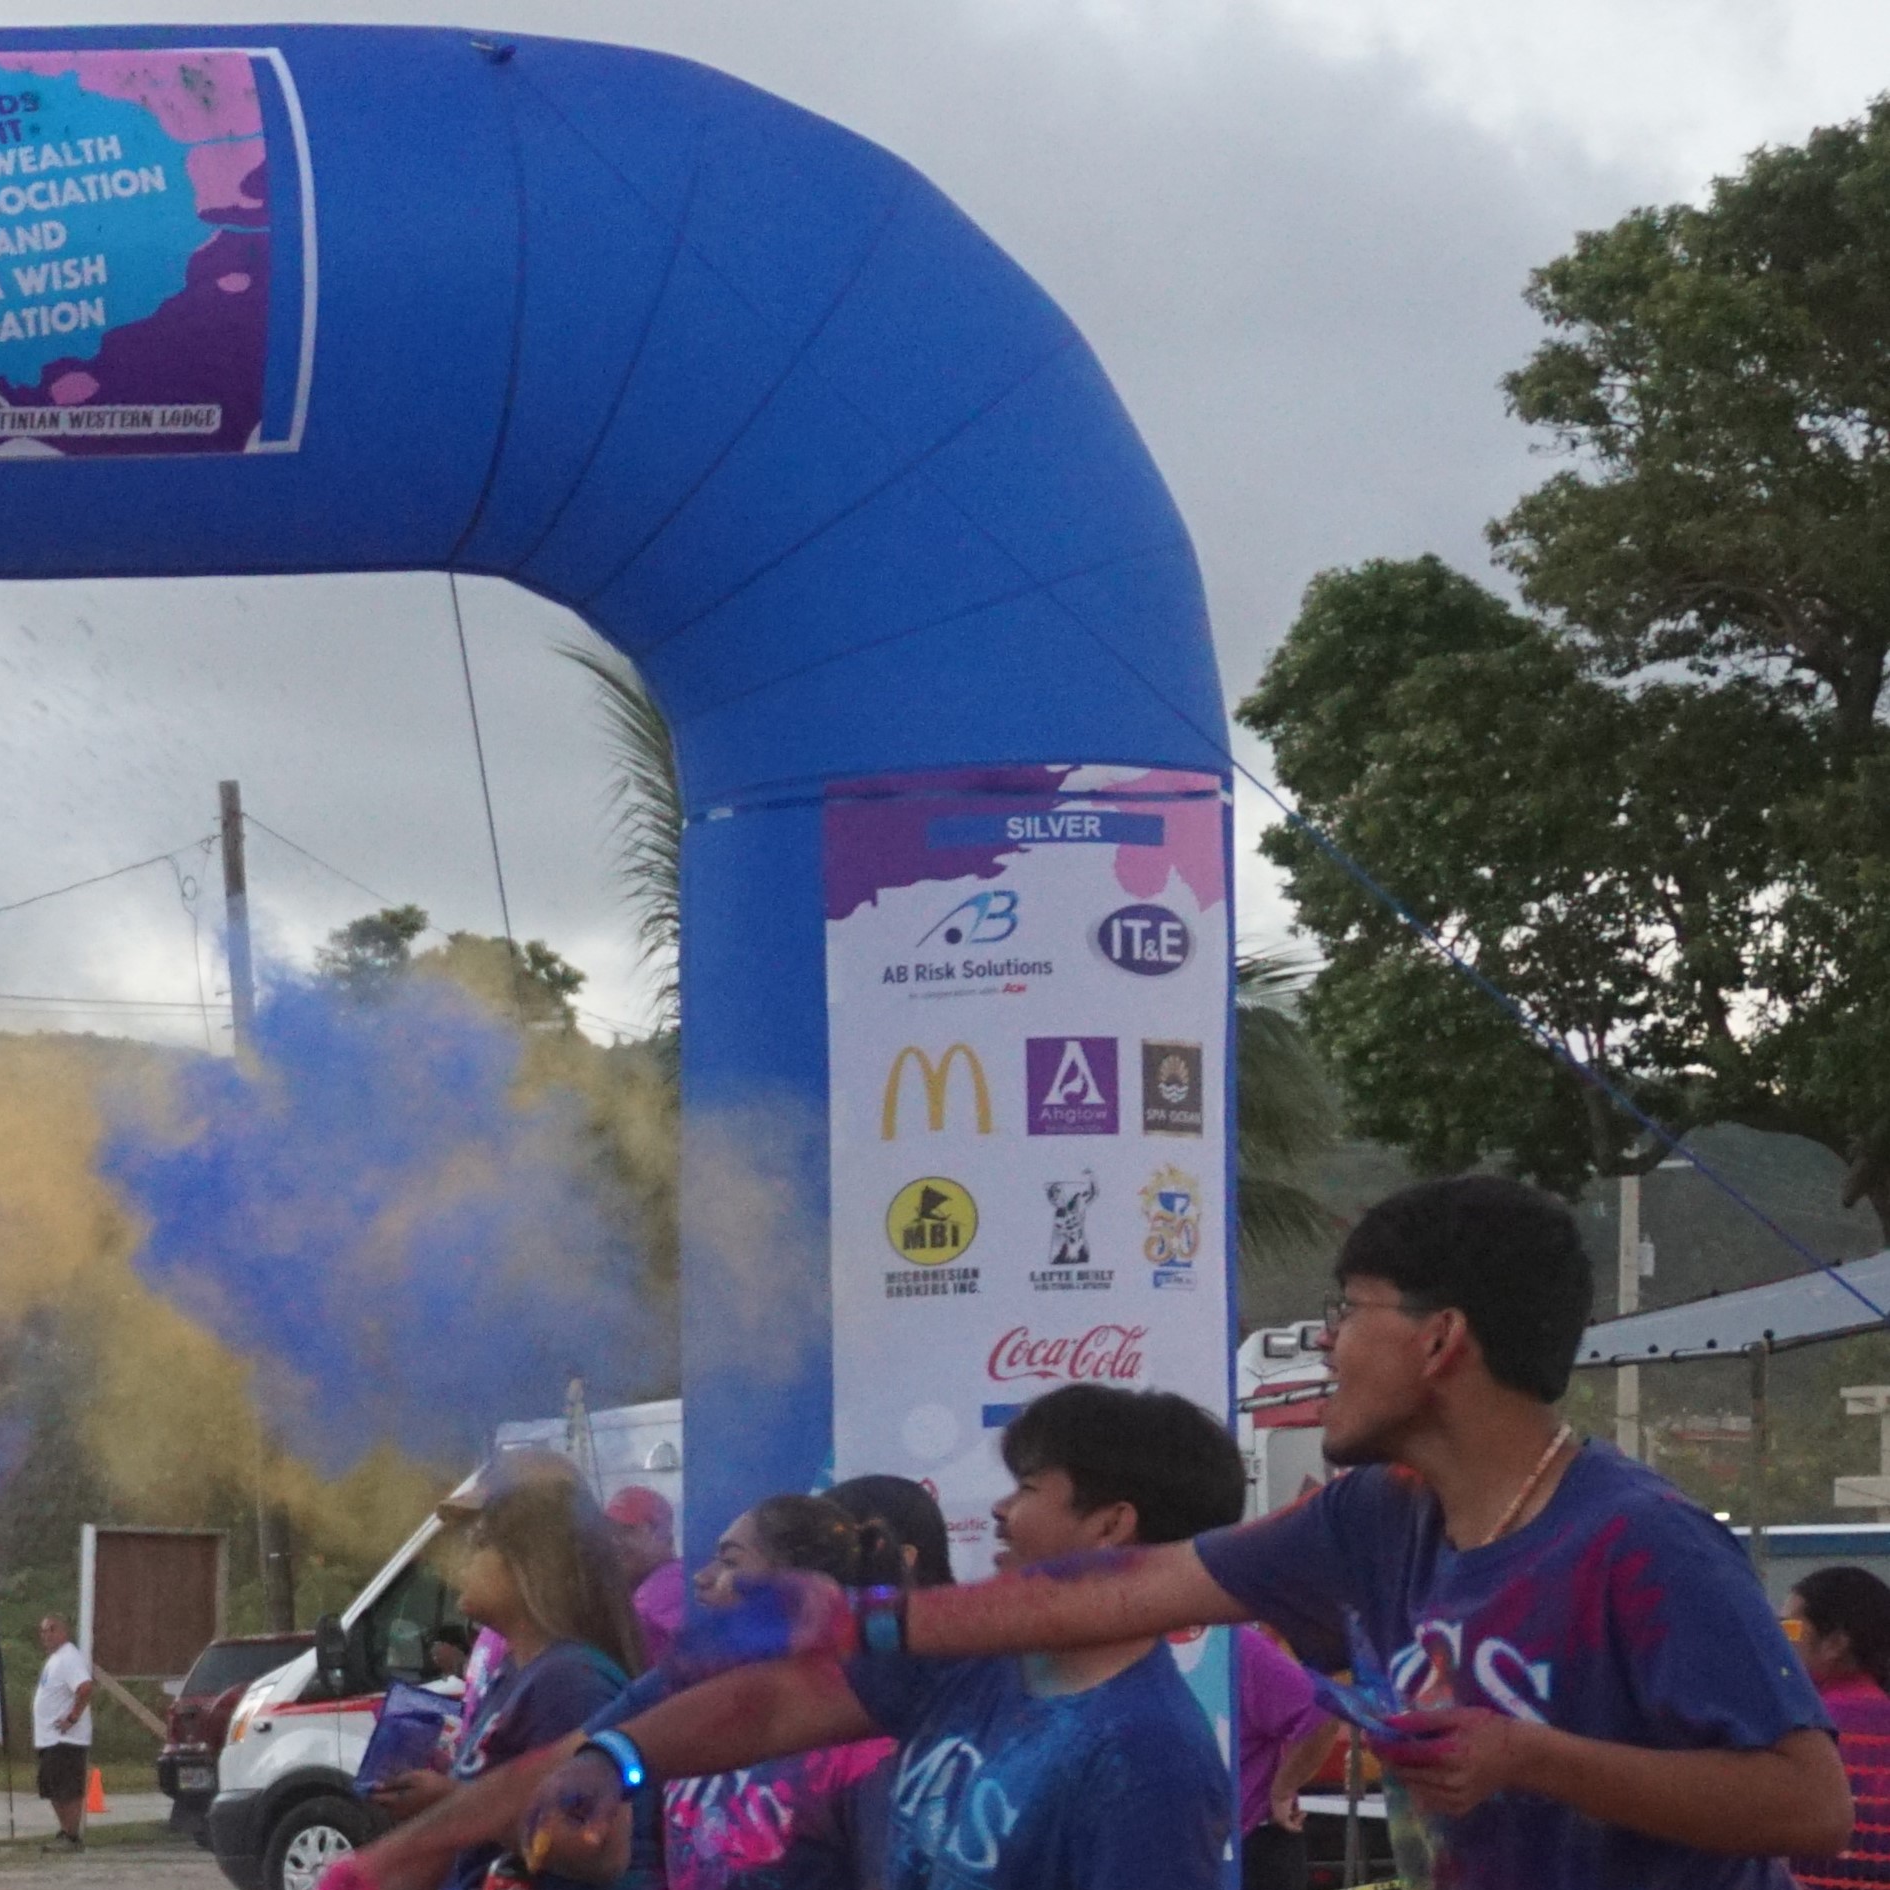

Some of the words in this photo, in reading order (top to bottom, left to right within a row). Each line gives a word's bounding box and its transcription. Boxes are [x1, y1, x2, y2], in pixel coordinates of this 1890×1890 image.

[12, 254, 107, 297] WISH
[69, 409, 154, 430] WESTERN
[160, 407, 216, 428] LODGE
[1006, 815, 1102, 839] SILVER
[1111, 918, 1183, 964] IT&E
[882, 965, 909, 985] AB
[914, 961, 956, 982] Risk
[962, 957, 1054, 981] Solutions
[902, 1221, 961, 1251] MBI
[986, 1323, 1149, 1382] Coca-Cola
